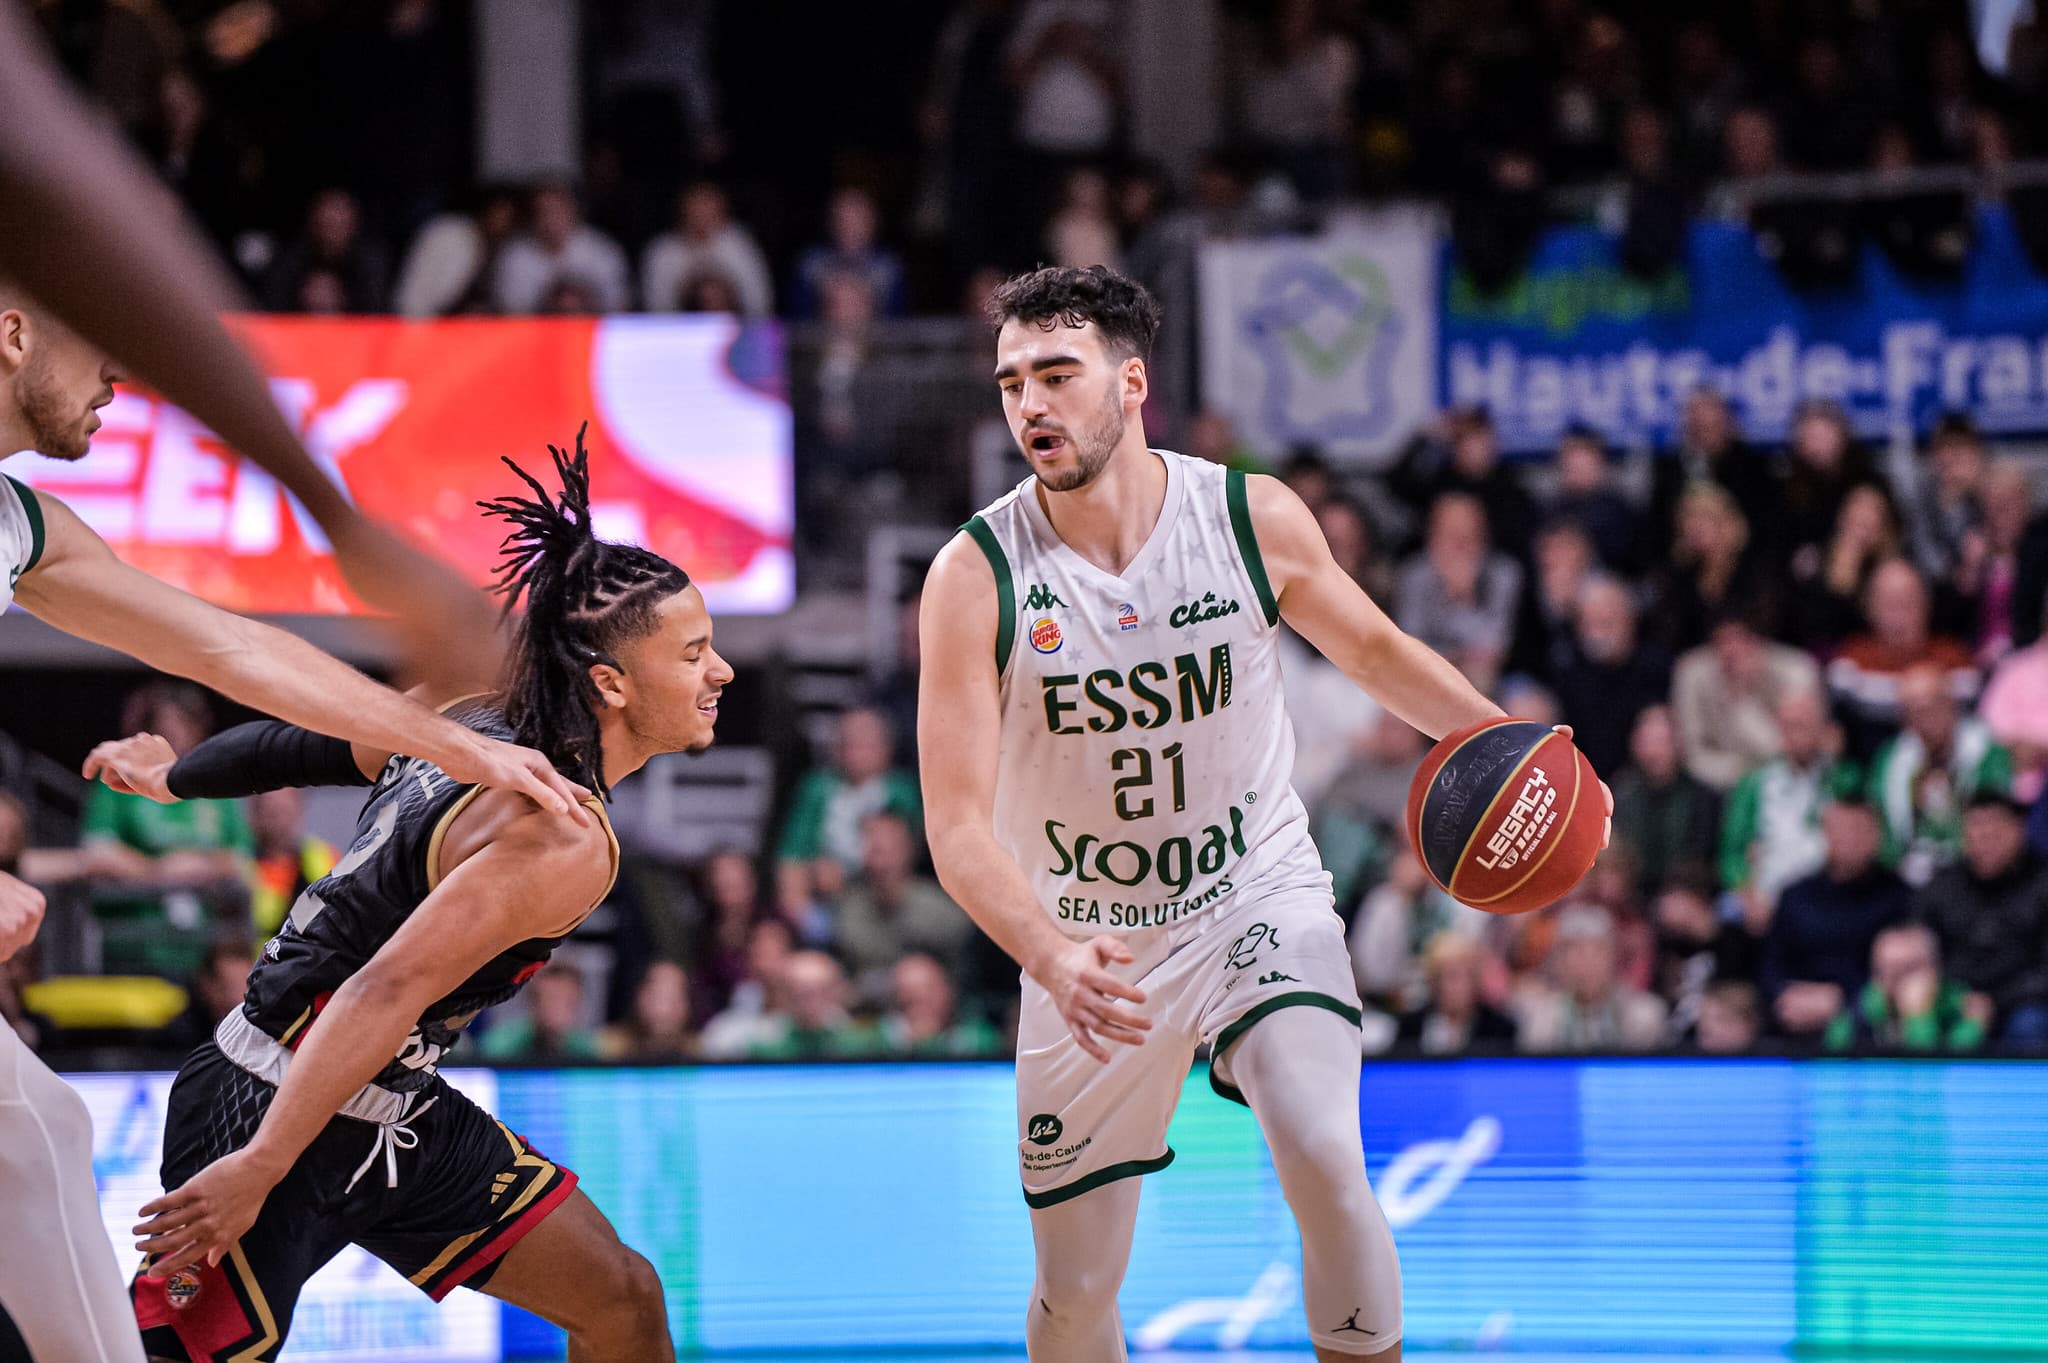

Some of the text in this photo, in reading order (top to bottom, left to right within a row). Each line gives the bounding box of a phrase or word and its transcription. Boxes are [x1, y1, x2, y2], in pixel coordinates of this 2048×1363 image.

[1034, 629, 1062, 648] KING
[1041, 642, 1233, 735] ESSM
[1111, 742, 1186, 821] 21
[1476, 767, 1549, 870] LEGACY
[1515, 787, 1557, 850] 1000
[1058, 874, 1234, 927] SEA SOLUTIONS
